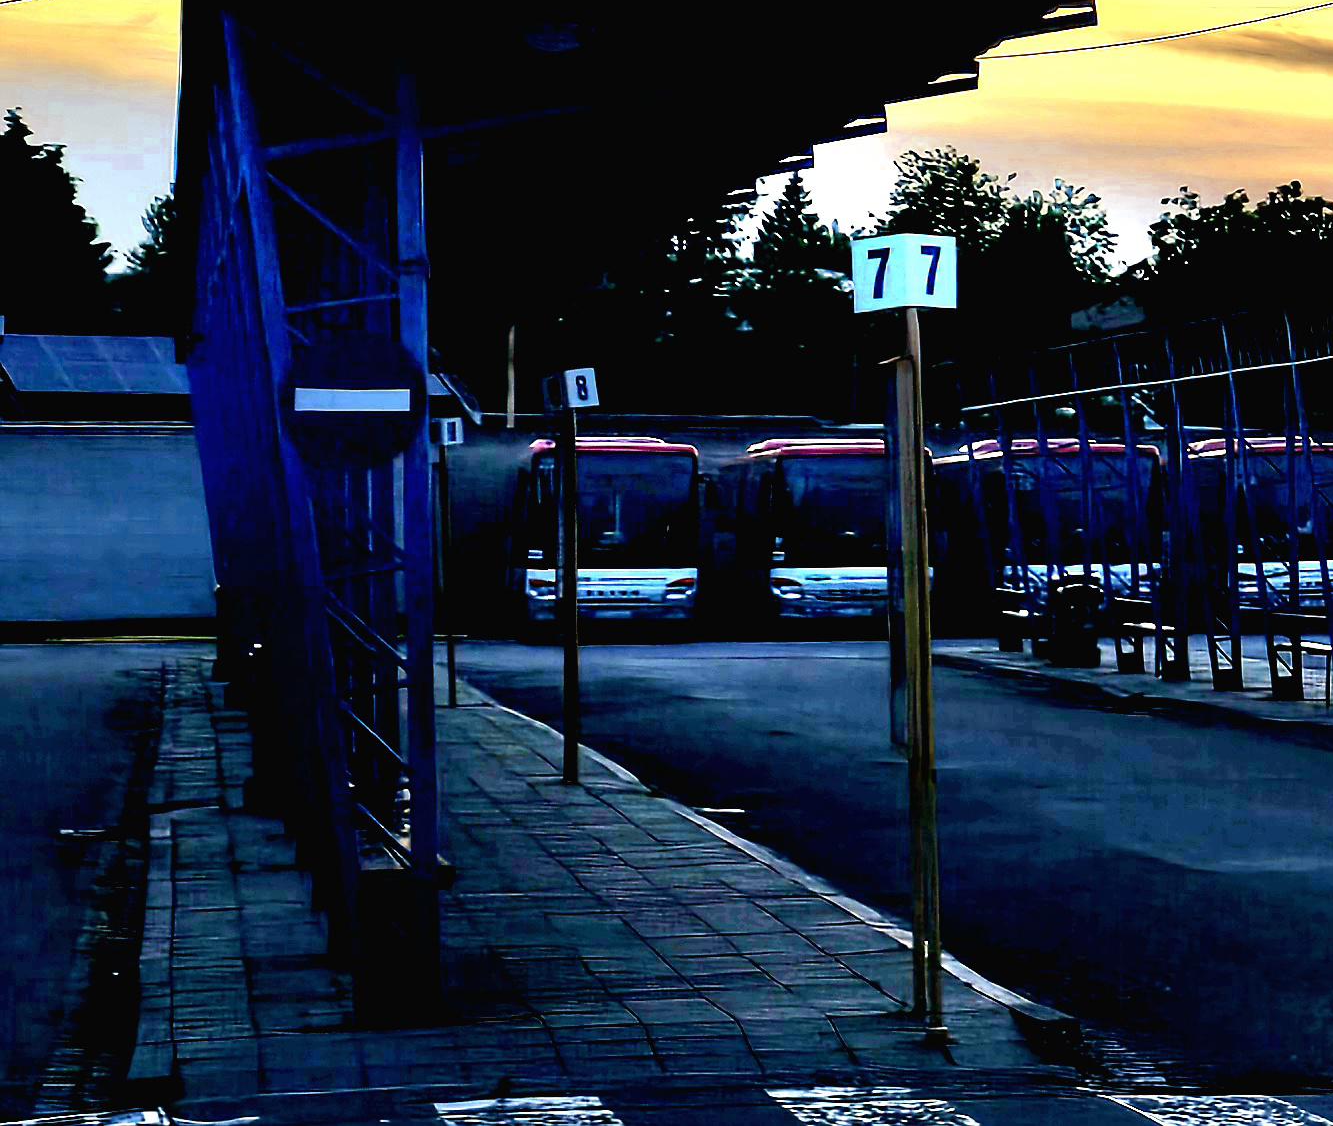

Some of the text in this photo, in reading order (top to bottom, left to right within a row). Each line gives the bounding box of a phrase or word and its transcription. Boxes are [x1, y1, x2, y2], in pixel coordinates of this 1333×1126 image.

[867, 247, 891, 299] 7
[920, 245, 941, 296] 7
[575, 375, 588, 401] 8
